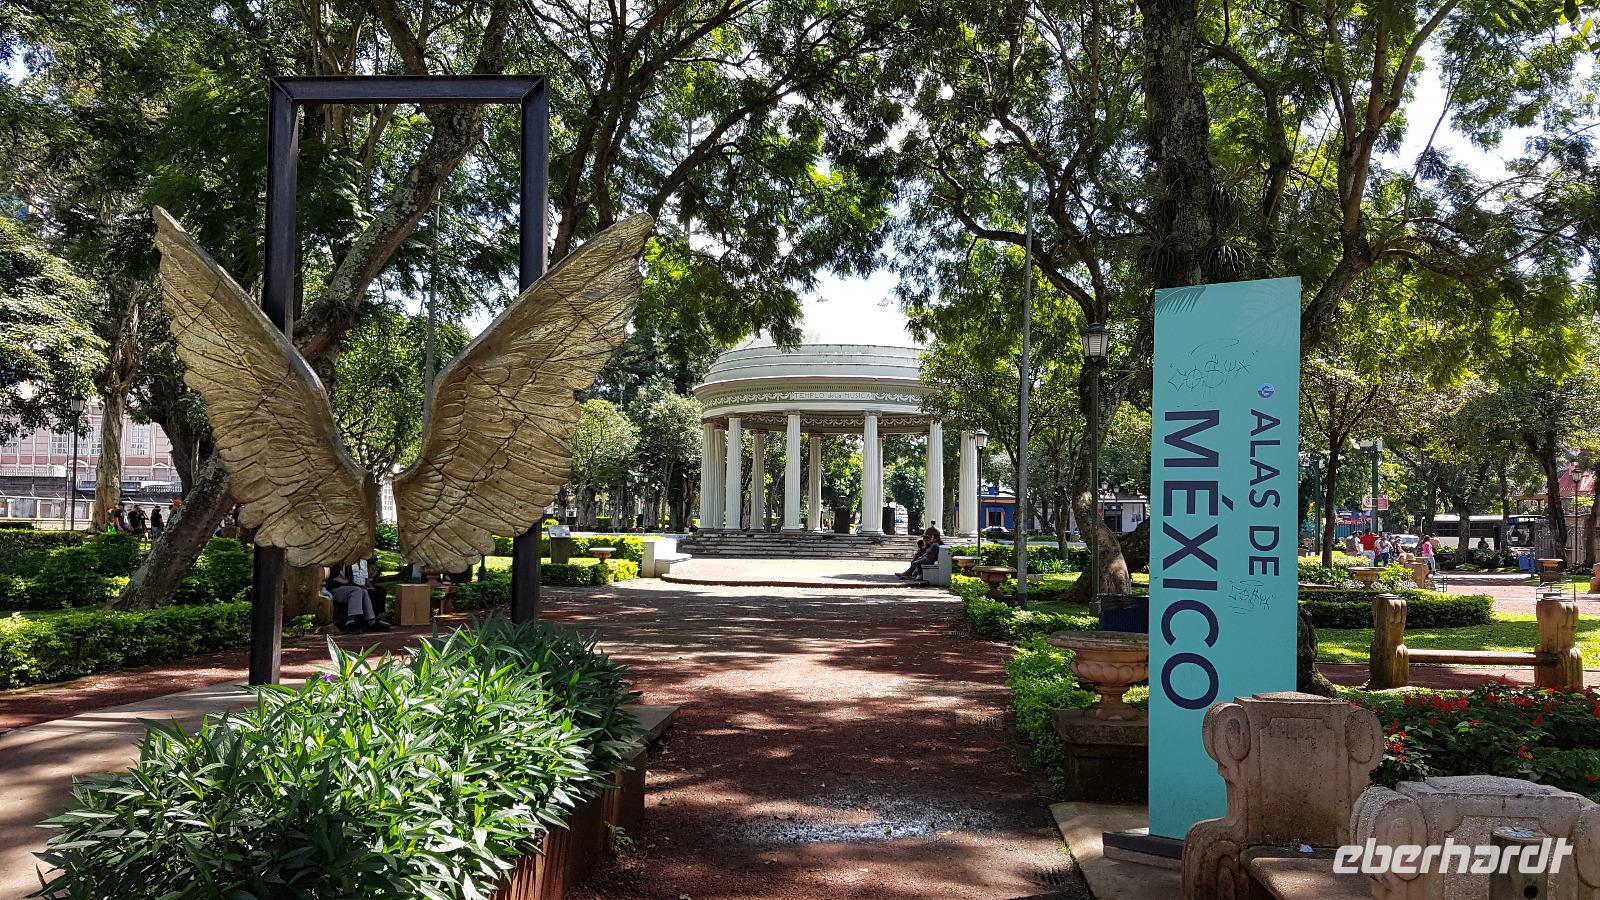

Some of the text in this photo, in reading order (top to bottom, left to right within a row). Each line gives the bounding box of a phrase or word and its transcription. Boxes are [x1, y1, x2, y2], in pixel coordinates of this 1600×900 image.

[1248, 409, 1281, 510] ALAS
[1160, 409, 1235, 710] MÉXICO
[1248, 525, 1280, 577] DE
